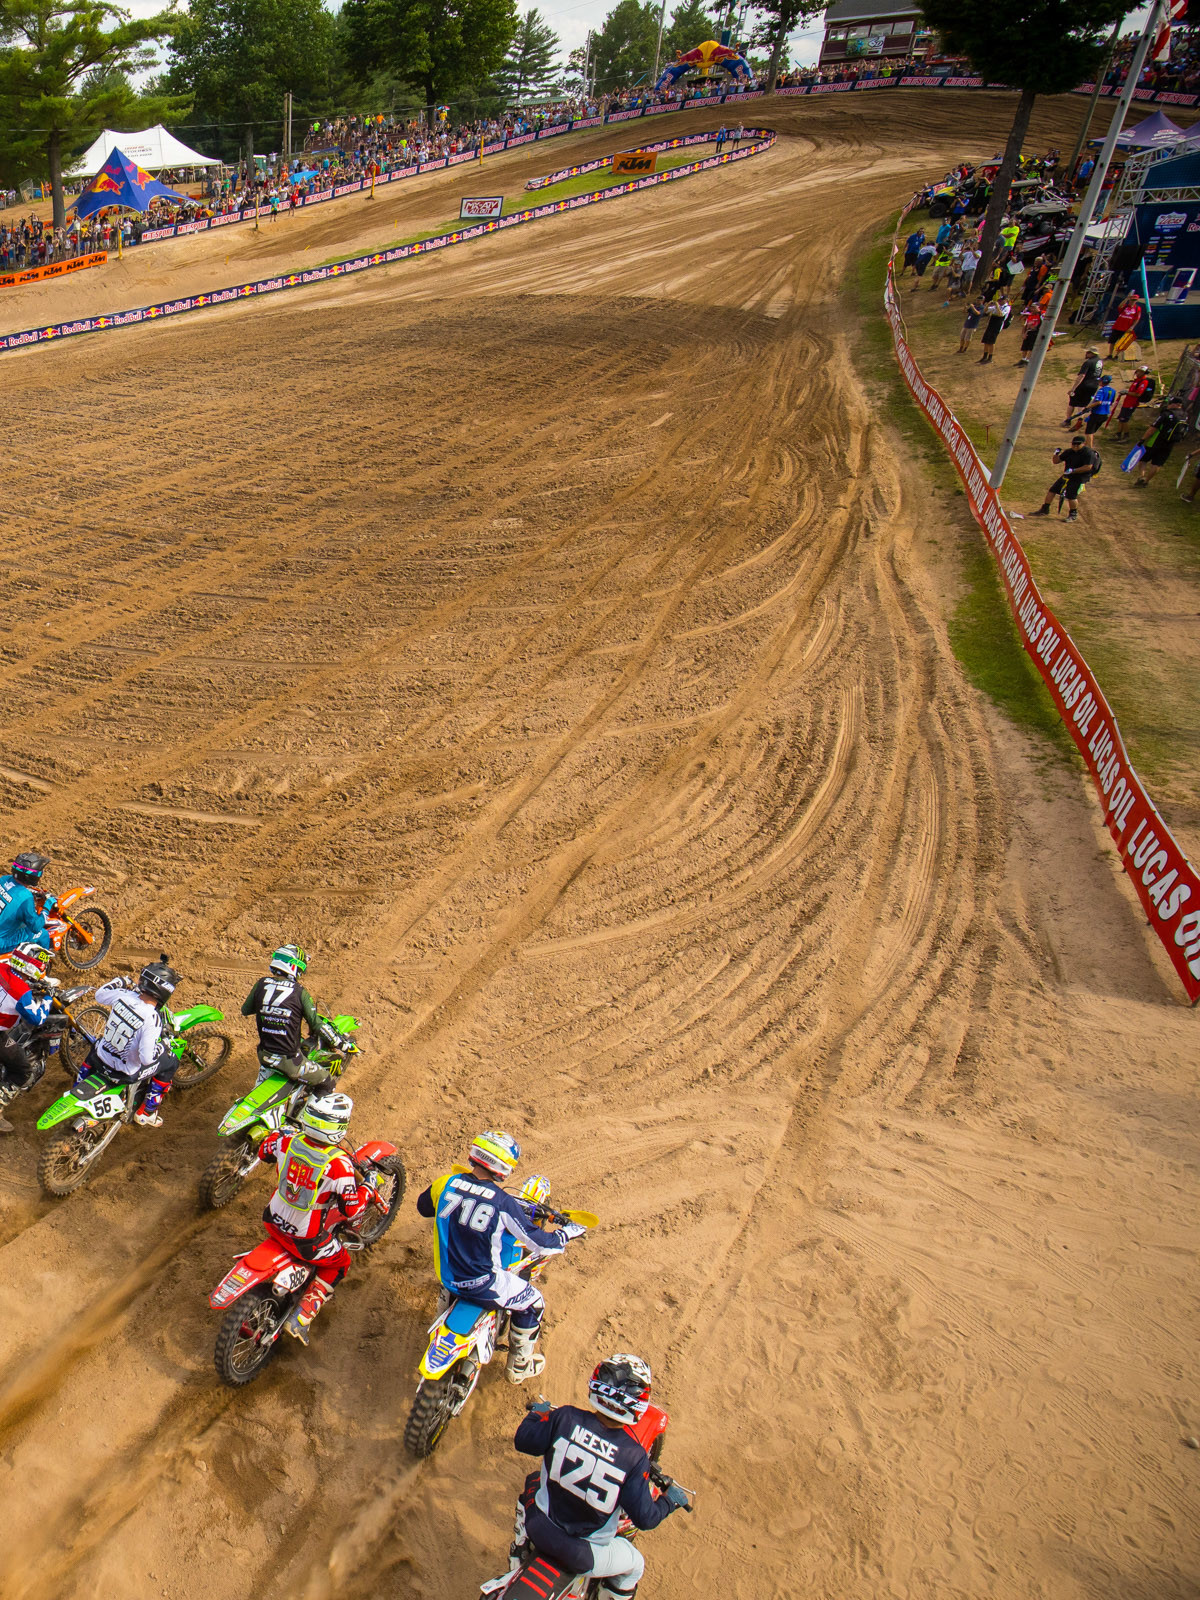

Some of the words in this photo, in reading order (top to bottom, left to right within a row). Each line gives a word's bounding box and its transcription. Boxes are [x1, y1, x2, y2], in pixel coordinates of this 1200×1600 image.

[617, 157, 652, 170] KTM
[983, 499, 1002, 540] LUCAS
[995, 529, 1008, 555] OIL
[1002, 541, 1023, 588] LUCAS
[1013, 572, 1029, 603] OIL
[1019, 589, 1047, 644] LUCAS
[1036, 625, 1062, 667] OIL
[1050, 648, 1087, 711] LUCAS
[1073, 688, 1100, 738] OIL
[1088, 719, 1121, 796] LUCAS
[1108, 776, 1136, 831] OIL
[1127, 818, 1191, 921] LUCAS
[263, 984, 295, 1006] 17
[103, 1017, 134, 1052] 56
[94, 1097, 112, 1118] 56
[438, 1191, 496, 1233] 716
[449, 1178, 496, 1200] DOWD
[570, 1424, 619, 1463] NEESE
[549, 1436, 627, 1514] 125
